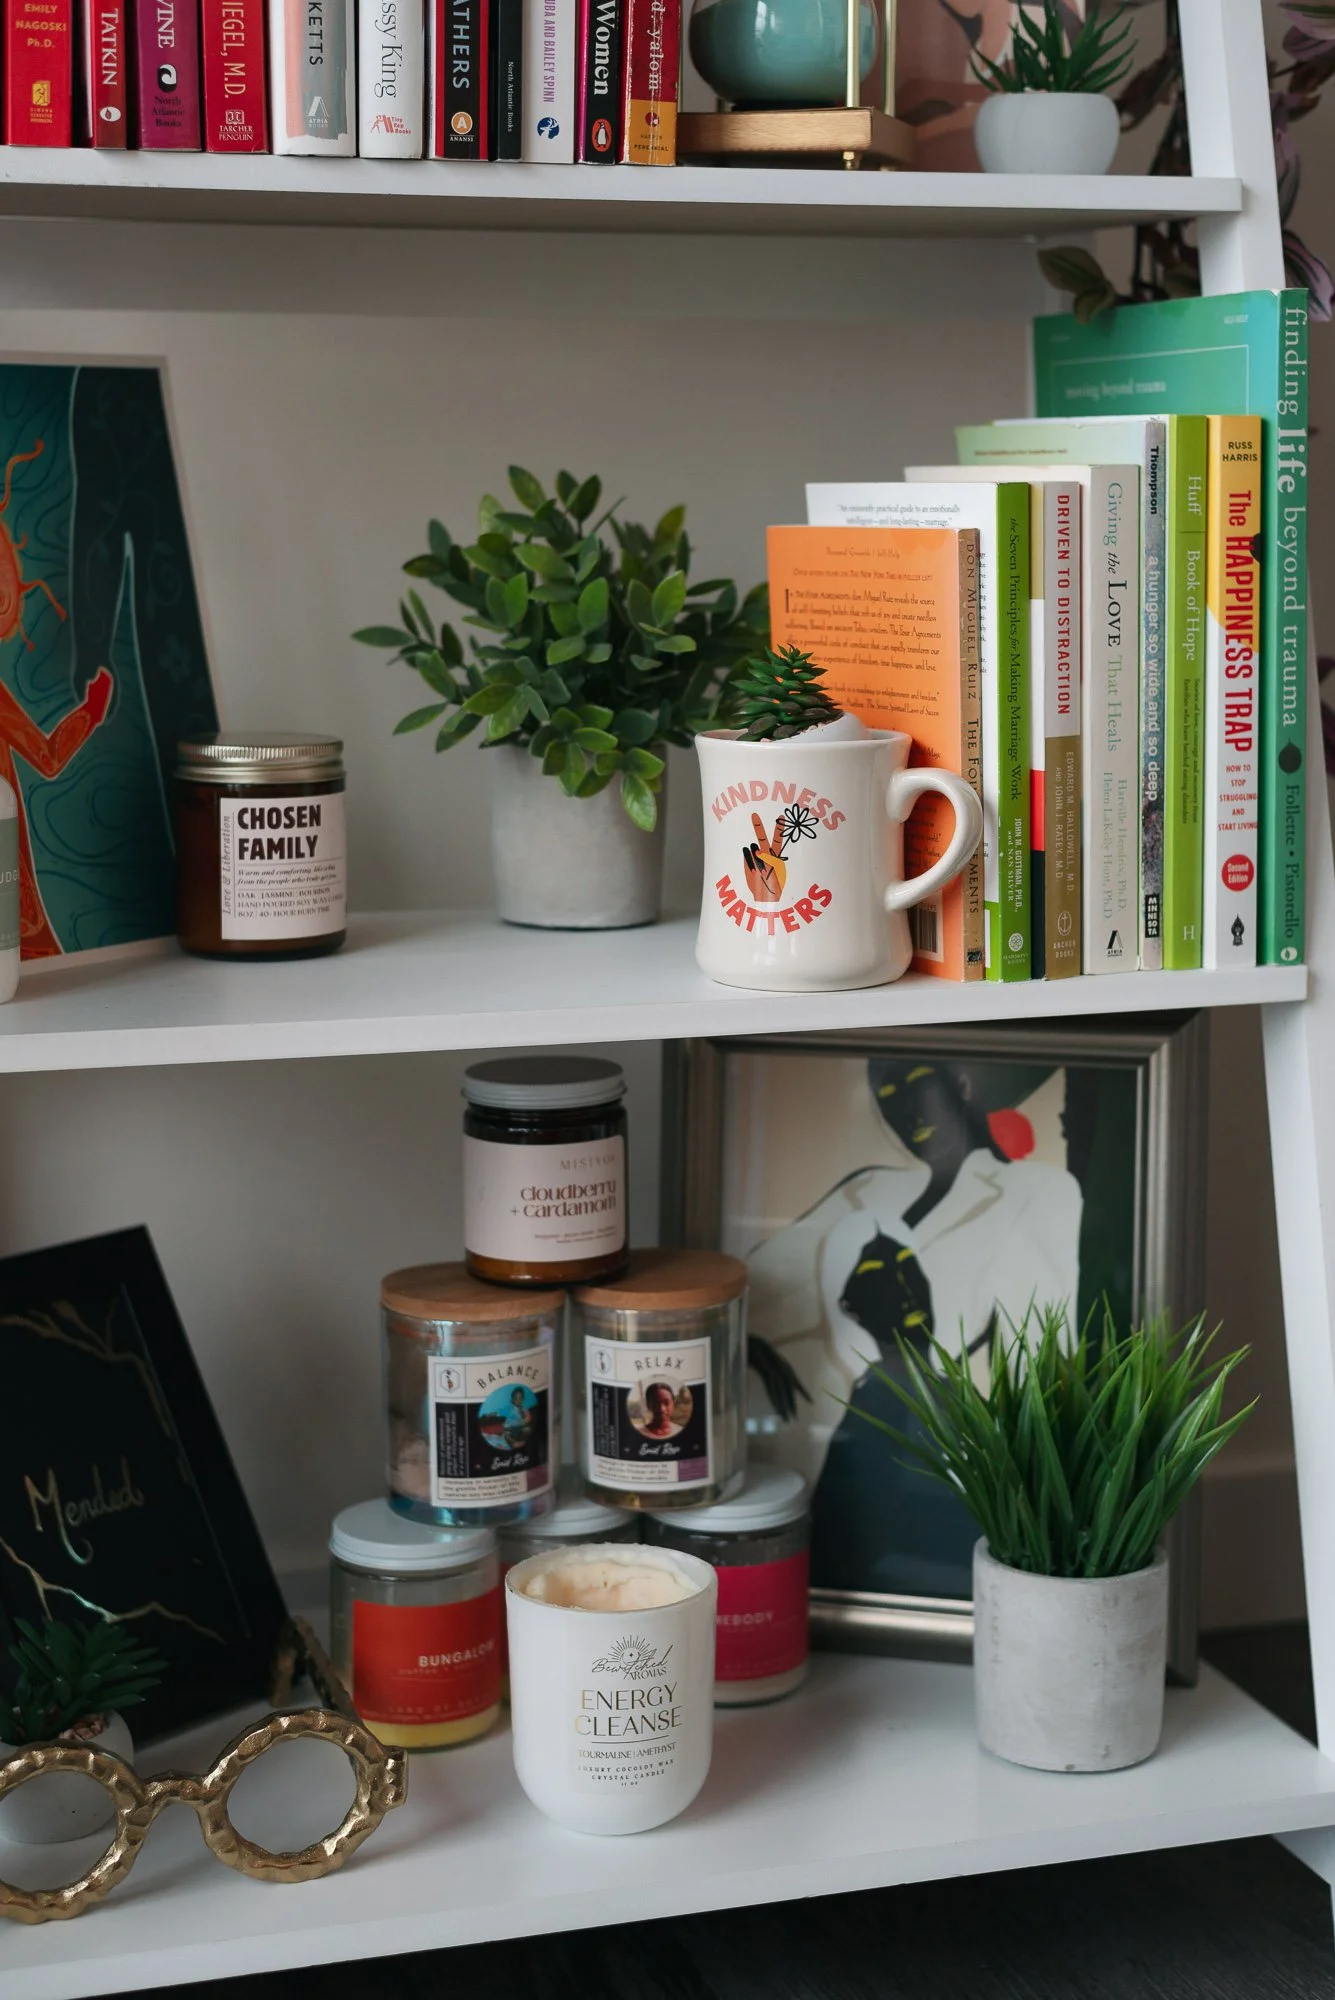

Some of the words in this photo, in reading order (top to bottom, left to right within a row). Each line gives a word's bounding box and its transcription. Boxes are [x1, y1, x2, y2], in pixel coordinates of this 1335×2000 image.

[25, 4, 58, 13] EMILY
[16, 20, 67, 31] NAGOSKI
[544, 19, 555, 38] AND
[27, 38, 55, 48] Ph.D.
[101, 8, 119, 86] TATKIN
[544, 40, 555, 73] BAILEY
[594, 0, 616, 95] Women
[373, 44, 403, 98] King
[647, 29, 664, 90] yalom
[223, 62, 246, 98] M.D.
[543, 74, 555, 103] SPINN
[152, 107, 185, 116] Atlantic
[155, 96, 182, 106] North
[156, 119, 182, 127] Books
[219, 125, 253, 133] TARCHER
[219, 133, 254, 141] PENGUIN
[1276, 307, 1308, 416] finding
[1222, 453, 1258, 462] HARRIS
[1228, 441, 1253, 450] RUSS
[1277, 427, 1308, 494] life
[1148, 446, 1159, 515] Thompson
[1187, 476, 1202, 517] Huff
[1102, 482, 1122, 547] Giving
[1229, 489, 1252, 527] The
[1057, 495, 1070, 560] DRIVEN
[966, 543, 976, 578] DON
[1009, 535, 1020, 570] Seven
[1108, 552, 1121, 575] the
[1149, 555, 1158, 566] a
[1277, 506, 1307, 612] beyond
[1057, 567, 1070, 589] TO
[1186, 550, 1201, 591] Book
[1007, 575, 1020, 636] Principles
[1108, 580, 1128, 648] LOVE
[1146, 571, 1160, 629] hunger
[1186, 596, 1201, 614] of
[1225, 536, 1255, 679] HAPPINESS
[966, 588, 977, 653] MIGUEL
[1009, 637, 1020, 652] for
[1148, 633, 1158, 654] so
[1183, 617, 1200, 661] Hope
[1057, 597, 1070, 715] DISTRACTION
[967, 663, 978, 700] RUIZ
[1007, 653, 1021, 702] Making
[1107, 655, 1122, 696] That
[1148, 658, 1160, 697] wide
[1283, 624, 1298, 727] trauma
[1107, 702, 1122, 752] Heals
[1148, 702, 1160, 732] and
[1225, 687, 1253, 752] TRAP
[968, 719, 979, 749] THE
[1007, 706, 1022, 762] Marriage
[1148, 736, 1158, 757] so
[1011, 765, 1022, 801] Work
[1066, 751, 1074, 792] EDWARD
[1145, 761, 1160, 801] deep
[1231, 779, 1247, 787] STOP
[1244, 764, 1252, 772] TO
[1056, 786, 1064, 810] JOHN
[1103, 772, 1113, 804] Helen
[1118, 779, 1127, 823] Harville
[1219, 793, 1258, 802] STRUGGLING
[237, 804, 322, 830] CHOSEN
[711, 780, 847, 832] KINDNESS
[1232, 808, 1246, 816] AND
[1286, 784, 1301, 847] Follette
[1014, 818, 1022, 841] JOHN
[1055, 824, 1064, 857] RATEY,
[1067, 810, 1075, 869] HALLOWELL,
[1102, 808, 1113, 850] LaKelly
[1218, 823, 1237, 831] START
[1238, 821, 1258, 830] LIVING
[221, 815, 231, 872] Liberation
[238, 835, 319, 861] FAMILY
[1117, 827, 1127, 876] Hendrix,
[238, 878, 255, 886] from
[256, 877, 267, 885] the
[268, 877, 290, 887] people
[261, 868, 275, 876] and
[1014, 850, 1023, 888] GOTTMAN,
[1067, 872, 1075, 895] M.D.
[1102, 854, 1113, 887] Hunt,
[1227, 863, 1249, 872] Second
[1227, 873, 1249, 884] Edition
[222, 889, 232, 915] Love
[261, 891, 293, 900] JASMINE
[299, 888, 331, 897] BOURBON
[262, 900, 295, 908] POURED
[715, 874, 832, 936] MATTERS
[1286, 862, 1301, 939] Pistorello
[273, 909, 297, 917] HOUR
[520, 1180, 617, 1202] cloudberry
[523, 1195, 617, 1219] cardamom
[476, 1366, 539, 1389] BALANCE
[634, 1356, 685, 1372] RELAX
[628, 1666, 668, 1681] AROMAS
[581, 1681, 678, 1711] ENERGY
[575, 1705, 684, 1737] CLEANSE
[579, 1748, 632, 1760] TOURMALINE
[636, 1741, 678, 1758] AMETHYST
[657, 1758, 676, 1767] WAX
[634, 1768, 666, 1779] CANDLE
